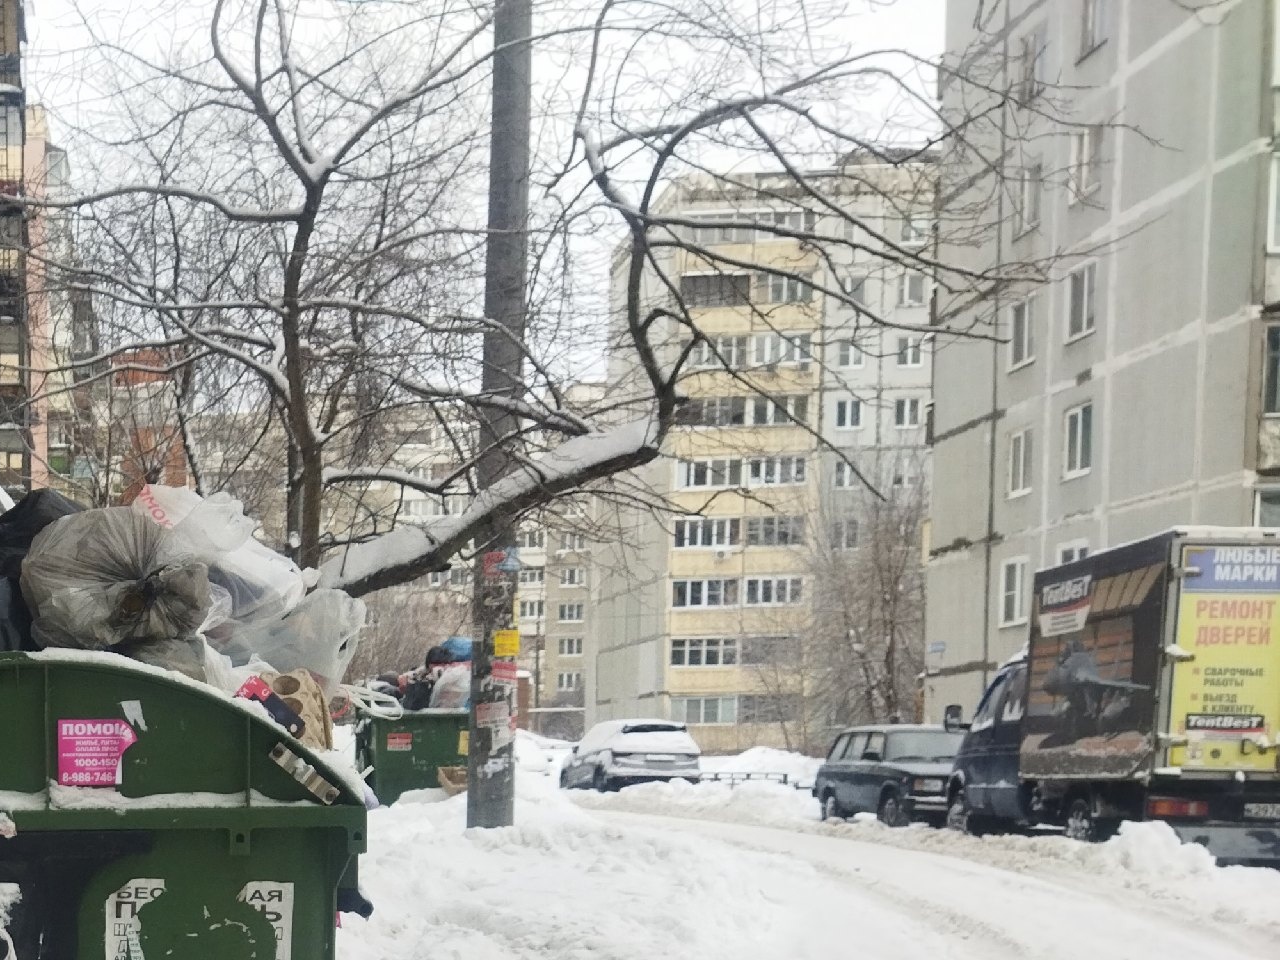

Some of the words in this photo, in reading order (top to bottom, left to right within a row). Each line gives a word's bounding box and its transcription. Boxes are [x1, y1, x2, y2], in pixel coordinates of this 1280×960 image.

[1214, 564, 1278, 581] МАРКИ
[1195, 600, 1276, 619] РЕМОНТ
[1203, 667, 1264, 677] СВАРОЧНЫЕ
[1203, 678, 1244, 687] РАБОТЫ
[1202, 693, 1237, 703] ВЫЕЗД
